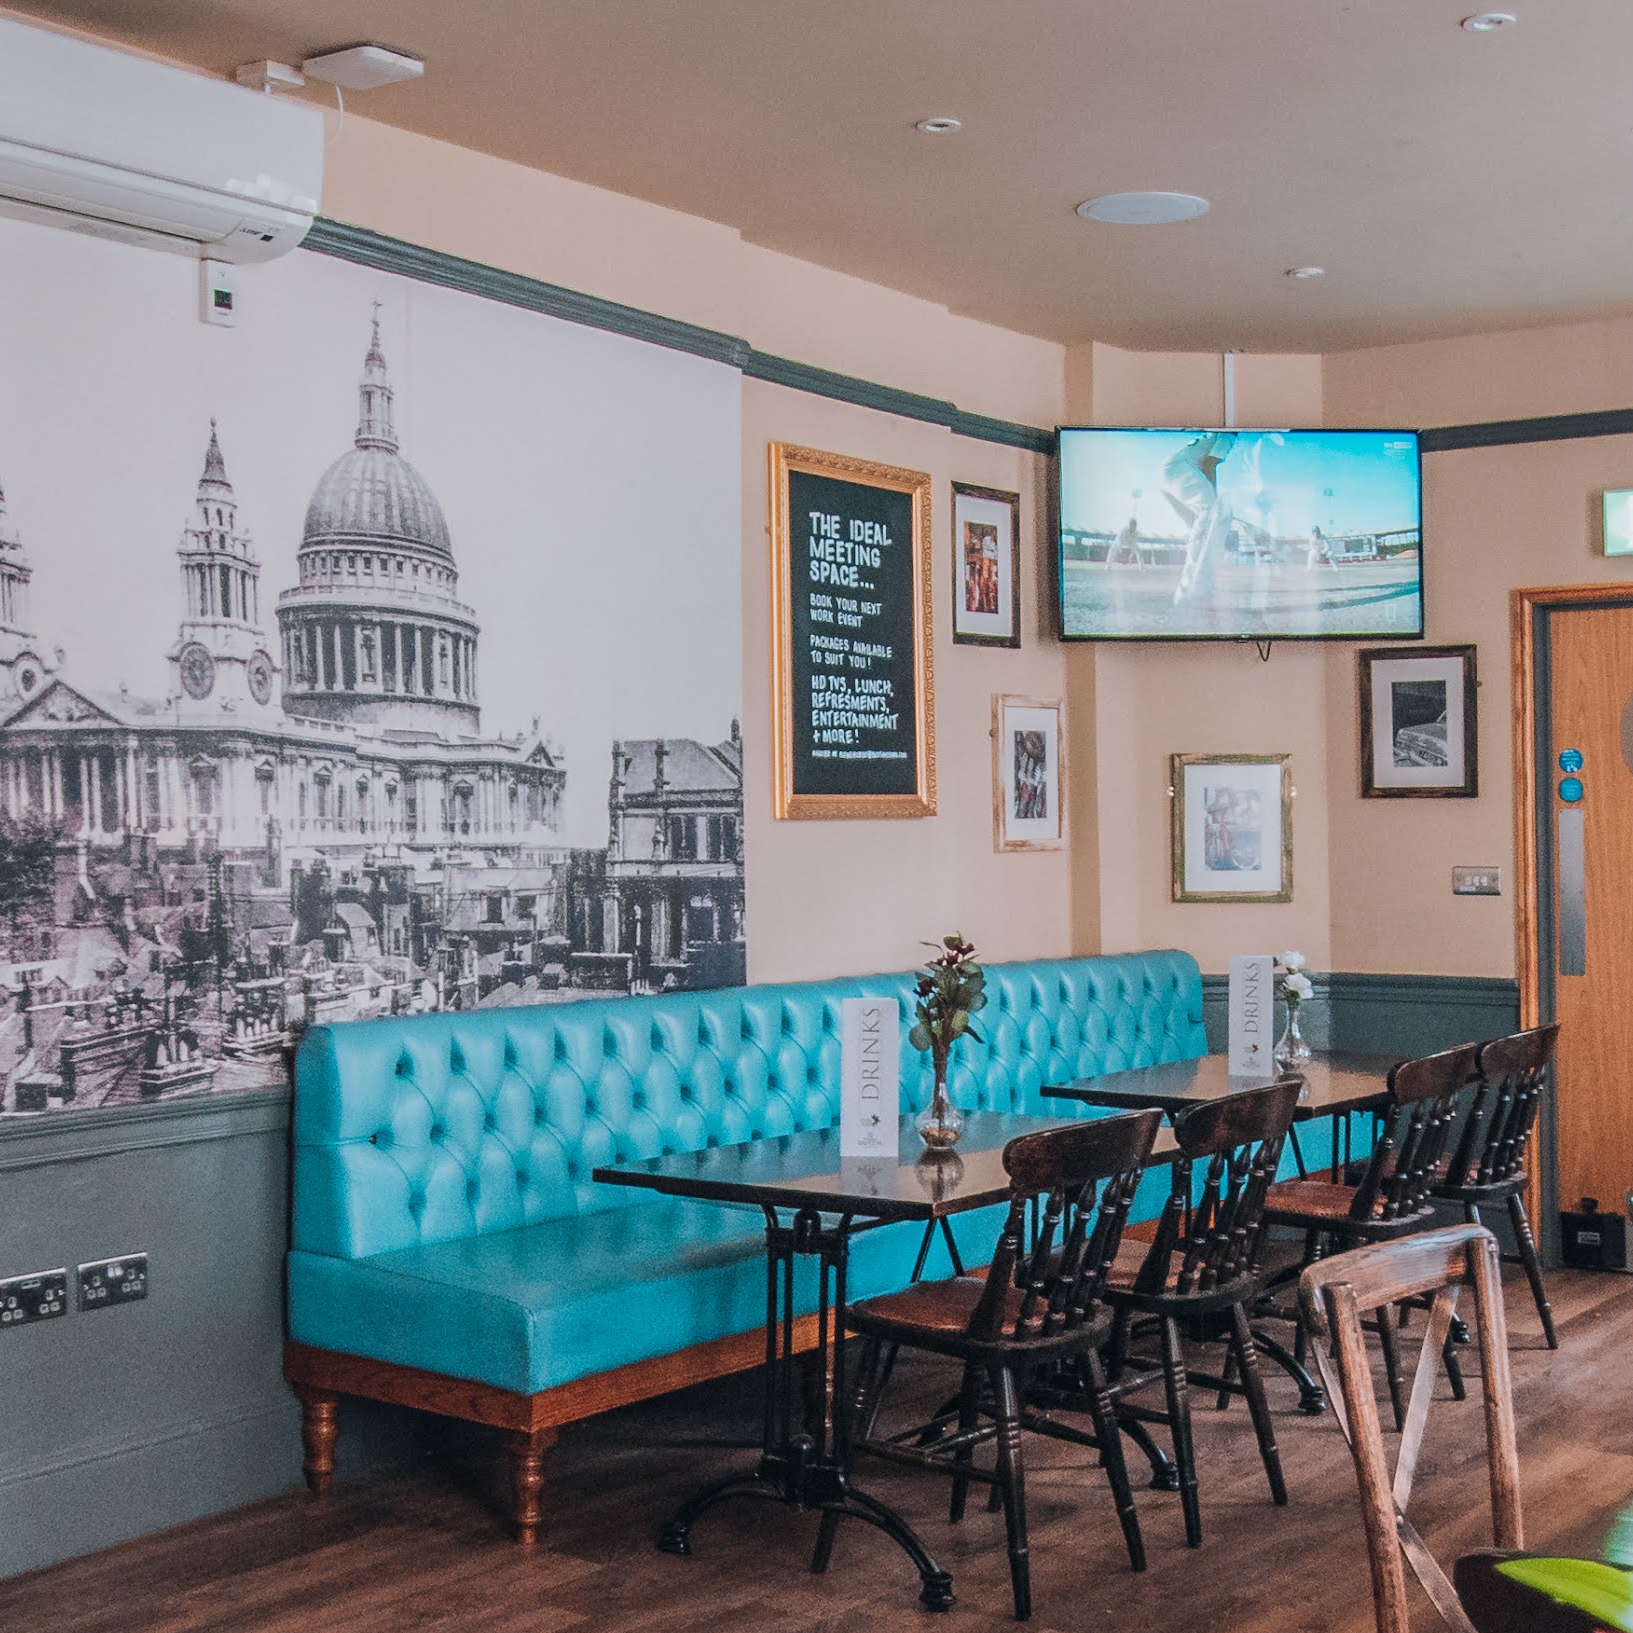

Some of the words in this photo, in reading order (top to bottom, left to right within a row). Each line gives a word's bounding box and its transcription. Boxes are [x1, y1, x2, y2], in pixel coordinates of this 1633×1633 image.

[809, 511, 841, 539] THE
[849, 519, 893, 546] IDEAL
[809, 536, 881, 568] MEETING
[809, 560, 875, 589] SPACE...
[810, 593, 833, 608] BOOK
[835, 597, 858, 612] YOUR
[861, 601, 882, 615] NEXT
[810, 608, 834, 624] WORK
[837, 612, 863, 628] EVENT
[810, 634, 850, 652] PACKAGES
[853, 640, 893, 659] AVAILABLE
[810, 649, 823, 663] TO
[824, 651, 845, 666] SUIT
[811, 675, 826, 690] HD
[854, 678, 894, 697] LUNCH,
[811, 691, 890, 713] REFRESMENTS,
[811, 709, 899, 730] ENTERTAINMENT
[1243, 962, 1259, 1033] DRINKS
[862, 1008, 880, 1099] DRINKS
